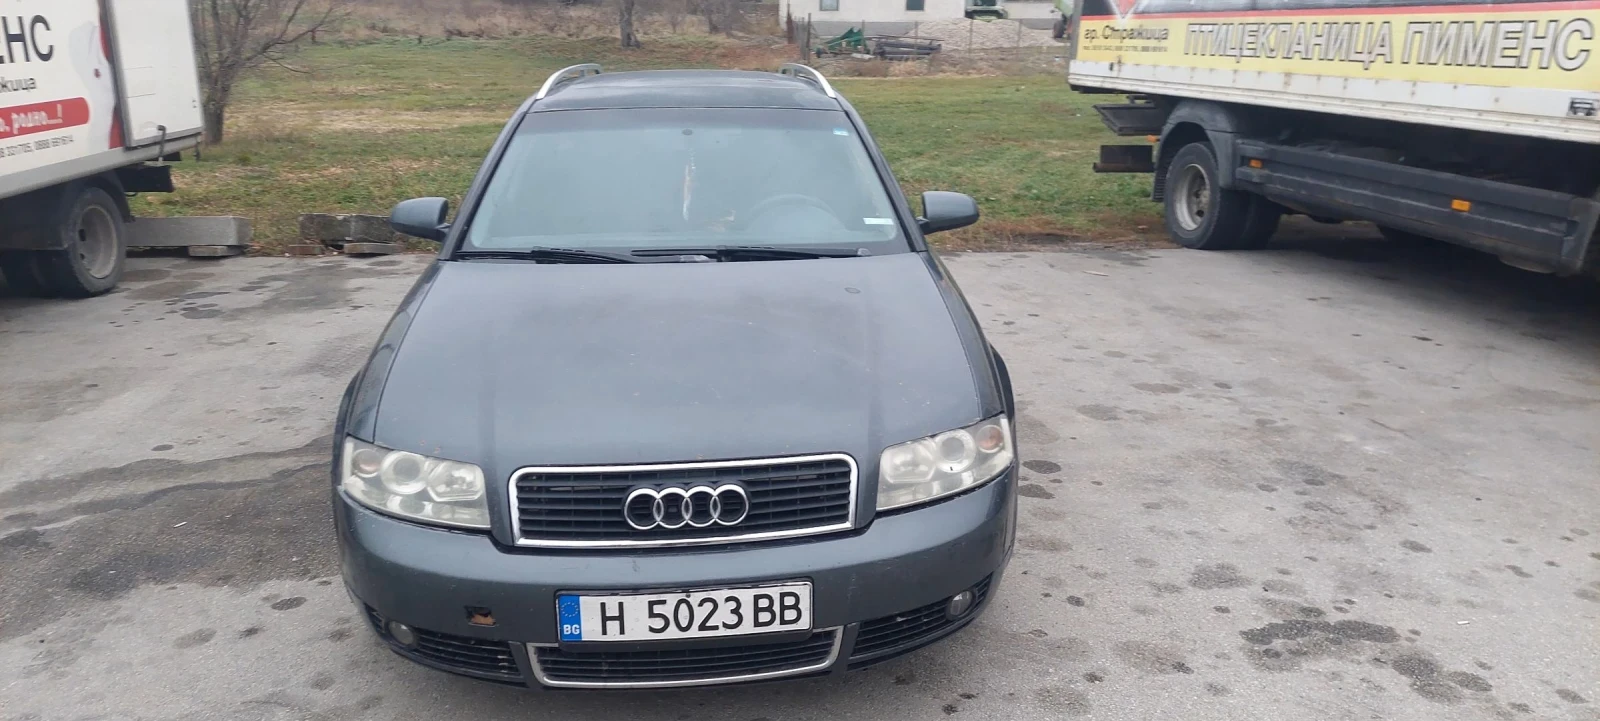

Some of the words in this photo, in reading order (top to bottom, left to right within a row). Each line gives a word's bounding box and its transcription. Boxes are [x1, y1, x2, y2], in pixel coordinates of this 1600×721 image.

[0, 14, 54, 64] НС
[1183, 21, 1394, 70] ПТИЦЕКЛАНИЦА
[1401, 18, 1594, 71] ПИМЕНС
[563, 624, 580, 635] BG
[600, 601, 625, 636] H
[647, 595, 744, 634] 5023
[753, 591, 803, 628] BB
